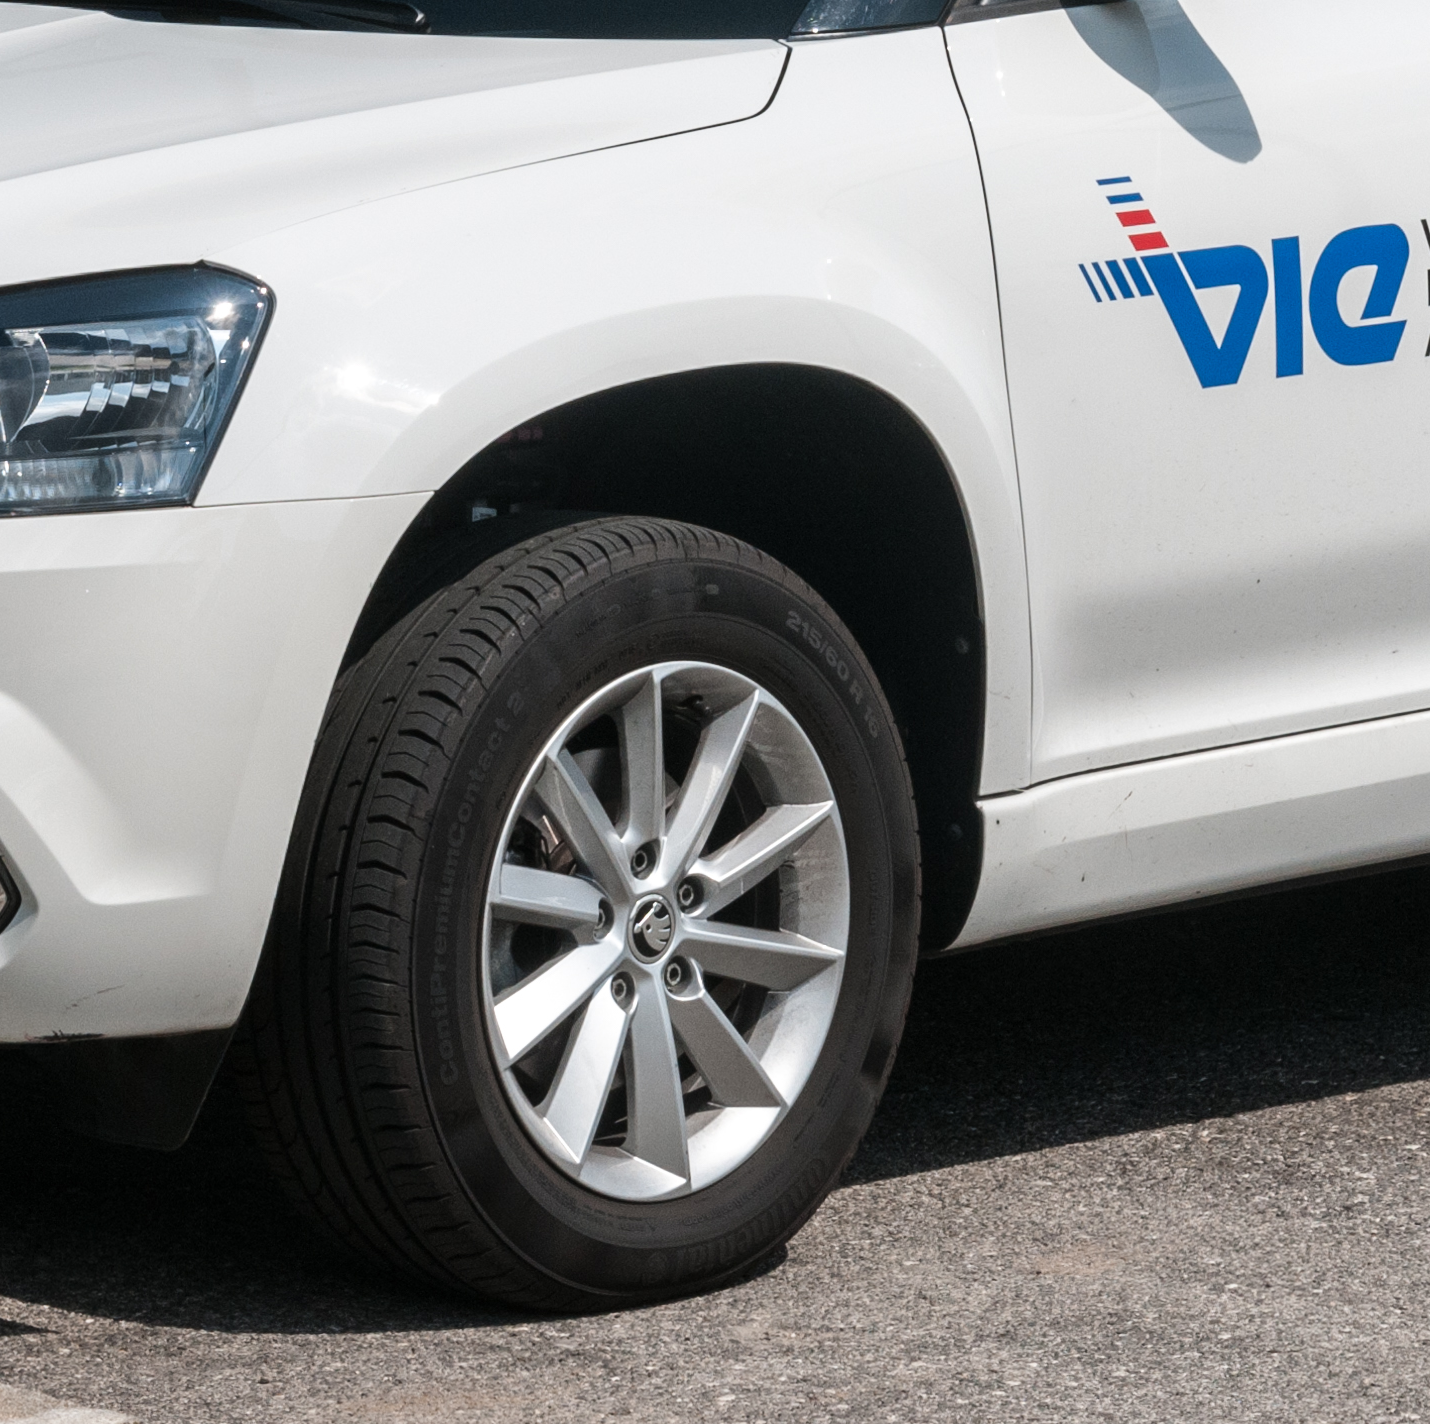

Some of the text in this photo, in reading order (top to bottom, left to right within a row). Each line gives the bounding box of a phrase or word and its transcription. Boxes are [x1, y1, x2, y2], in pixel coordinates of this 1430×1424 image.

[785, 610, 849, 681] 215/60
[849, 678, 864, 705] R
[429, 689, 526, 1086] ContiPremiumContact 2
